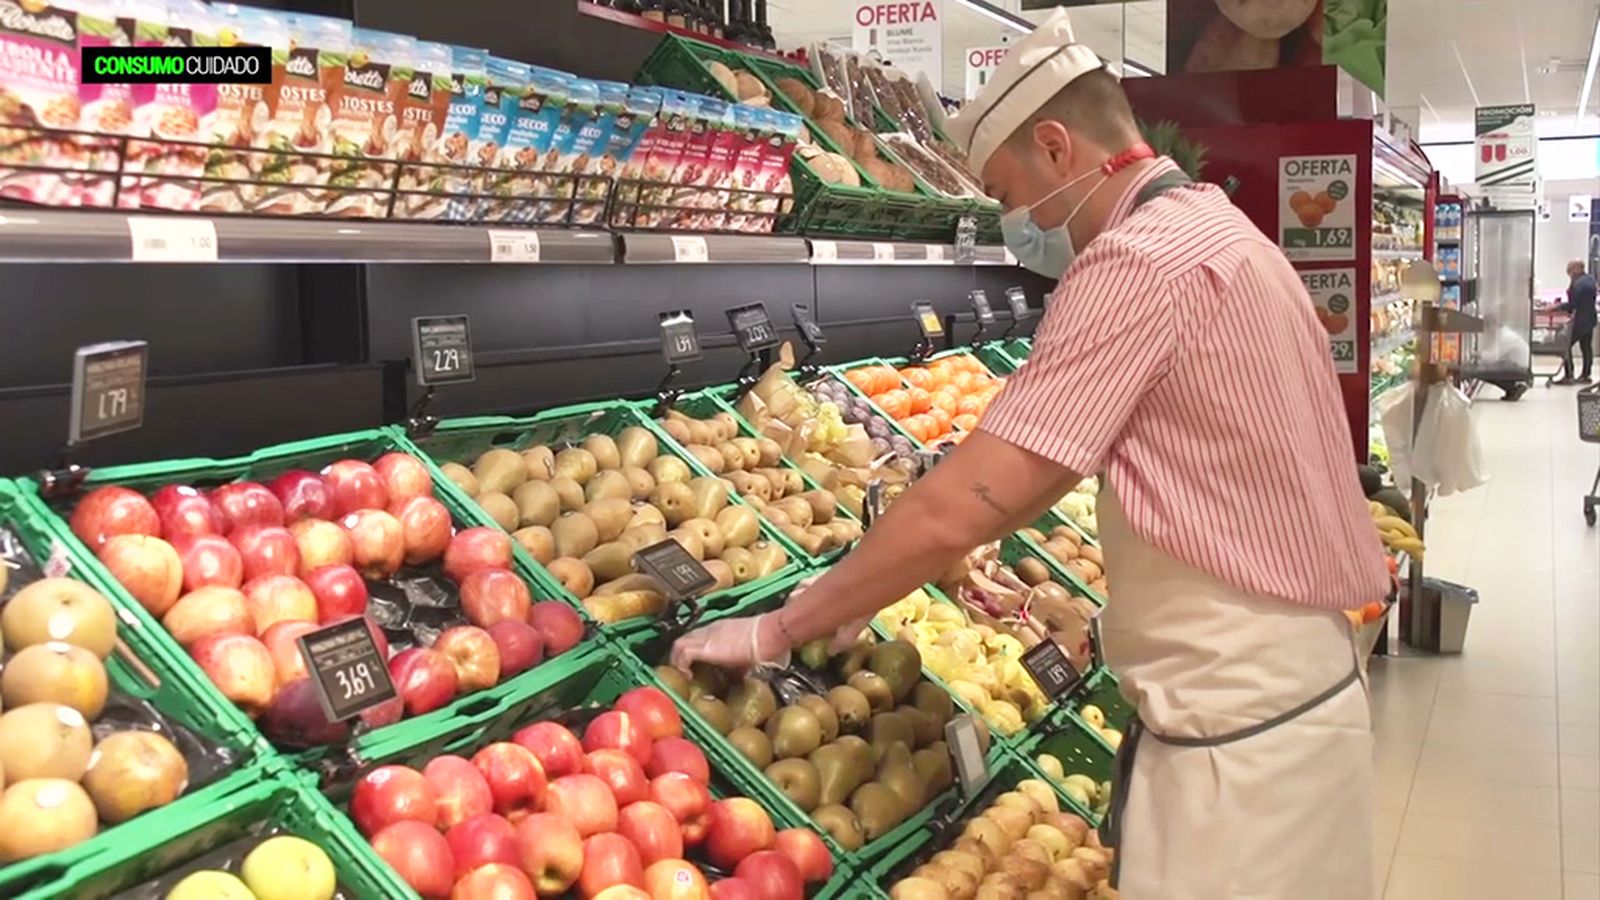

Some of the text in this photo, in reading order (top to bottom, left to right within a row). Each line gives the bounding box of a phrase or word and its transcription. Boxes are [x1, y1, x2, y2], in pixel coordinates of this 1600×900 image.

[856, 2, 936, 26] OFERTA
[969, 49, 1009, 67] OFE
[1285, 159, 1352, 177] OFERTA
[1301, 272, 1351, 290] FERTA
[335, 662, 375, 700] 3.69
